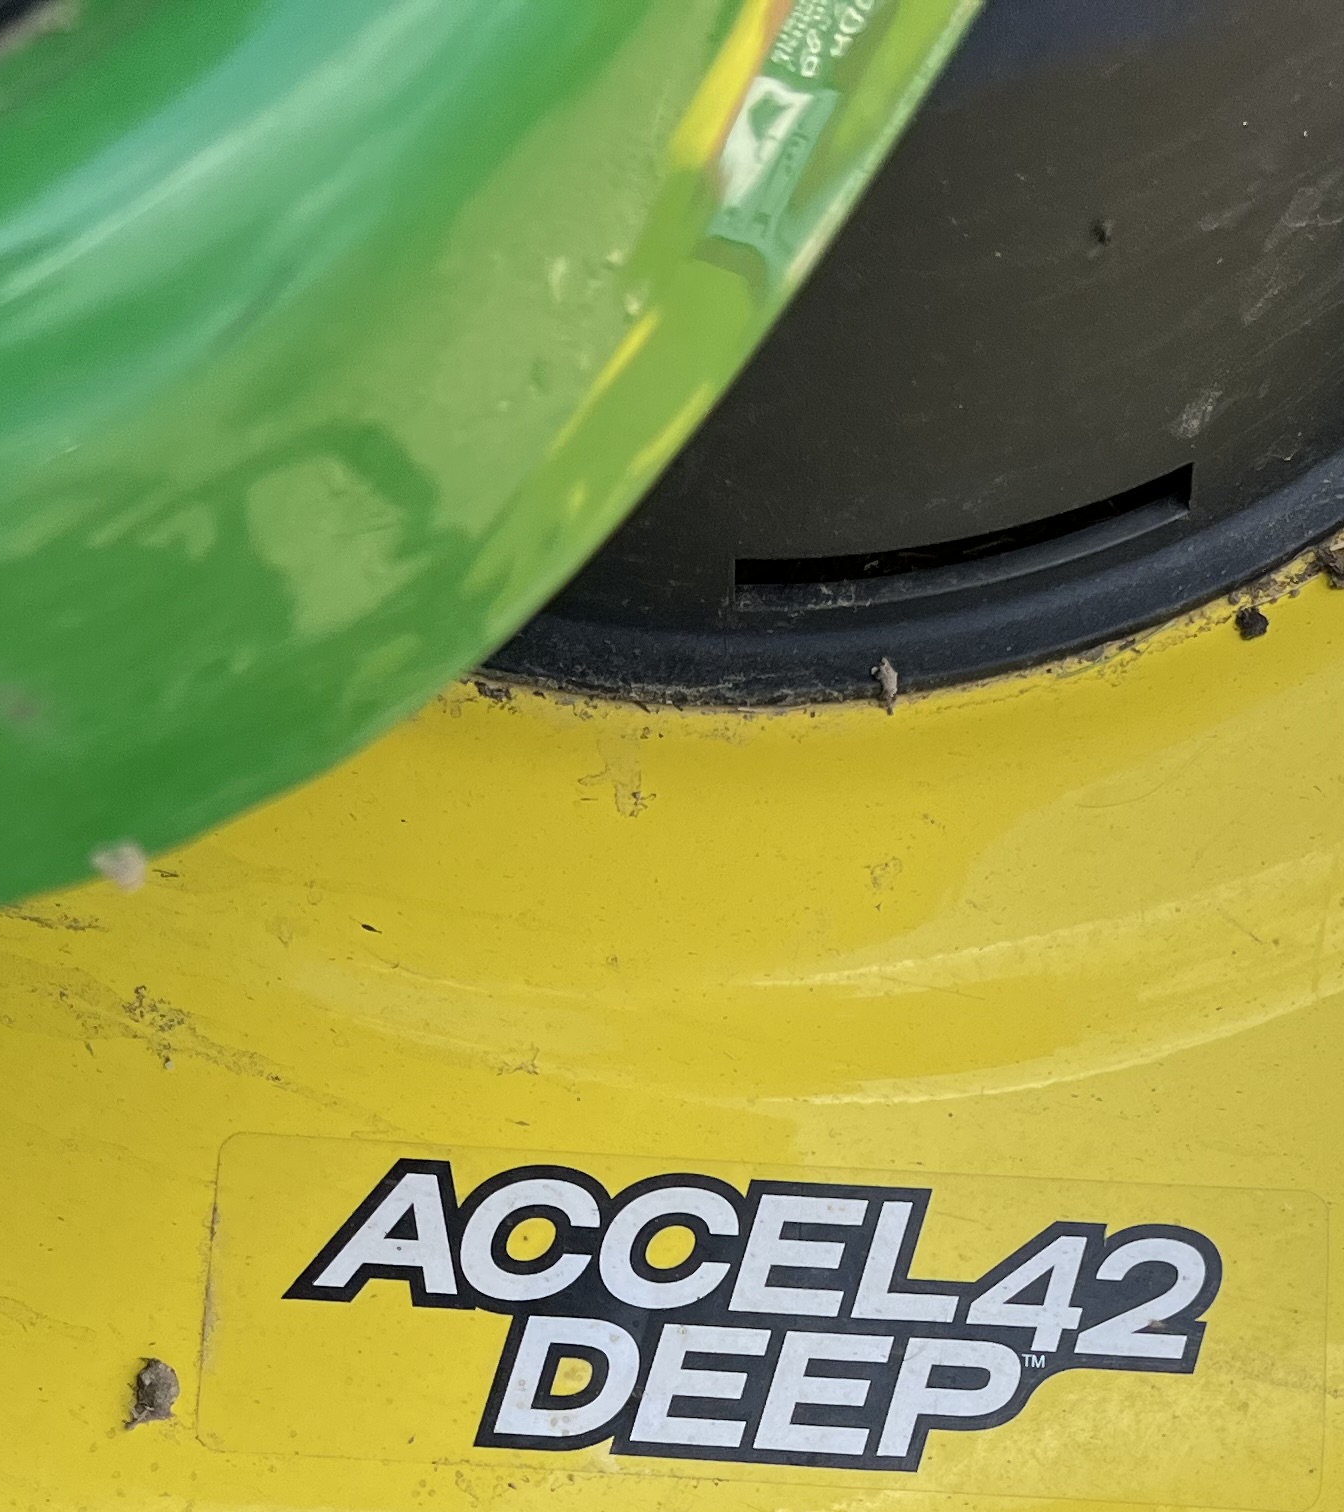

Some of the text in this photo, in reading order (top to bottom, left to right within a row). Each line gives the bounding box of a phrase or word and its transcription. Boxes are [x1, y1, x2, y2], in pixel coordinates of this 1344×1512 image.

[313, 1172, 1206, 1360] ACCEL 42
[493, 1315, 1022, 1457] DEEP
